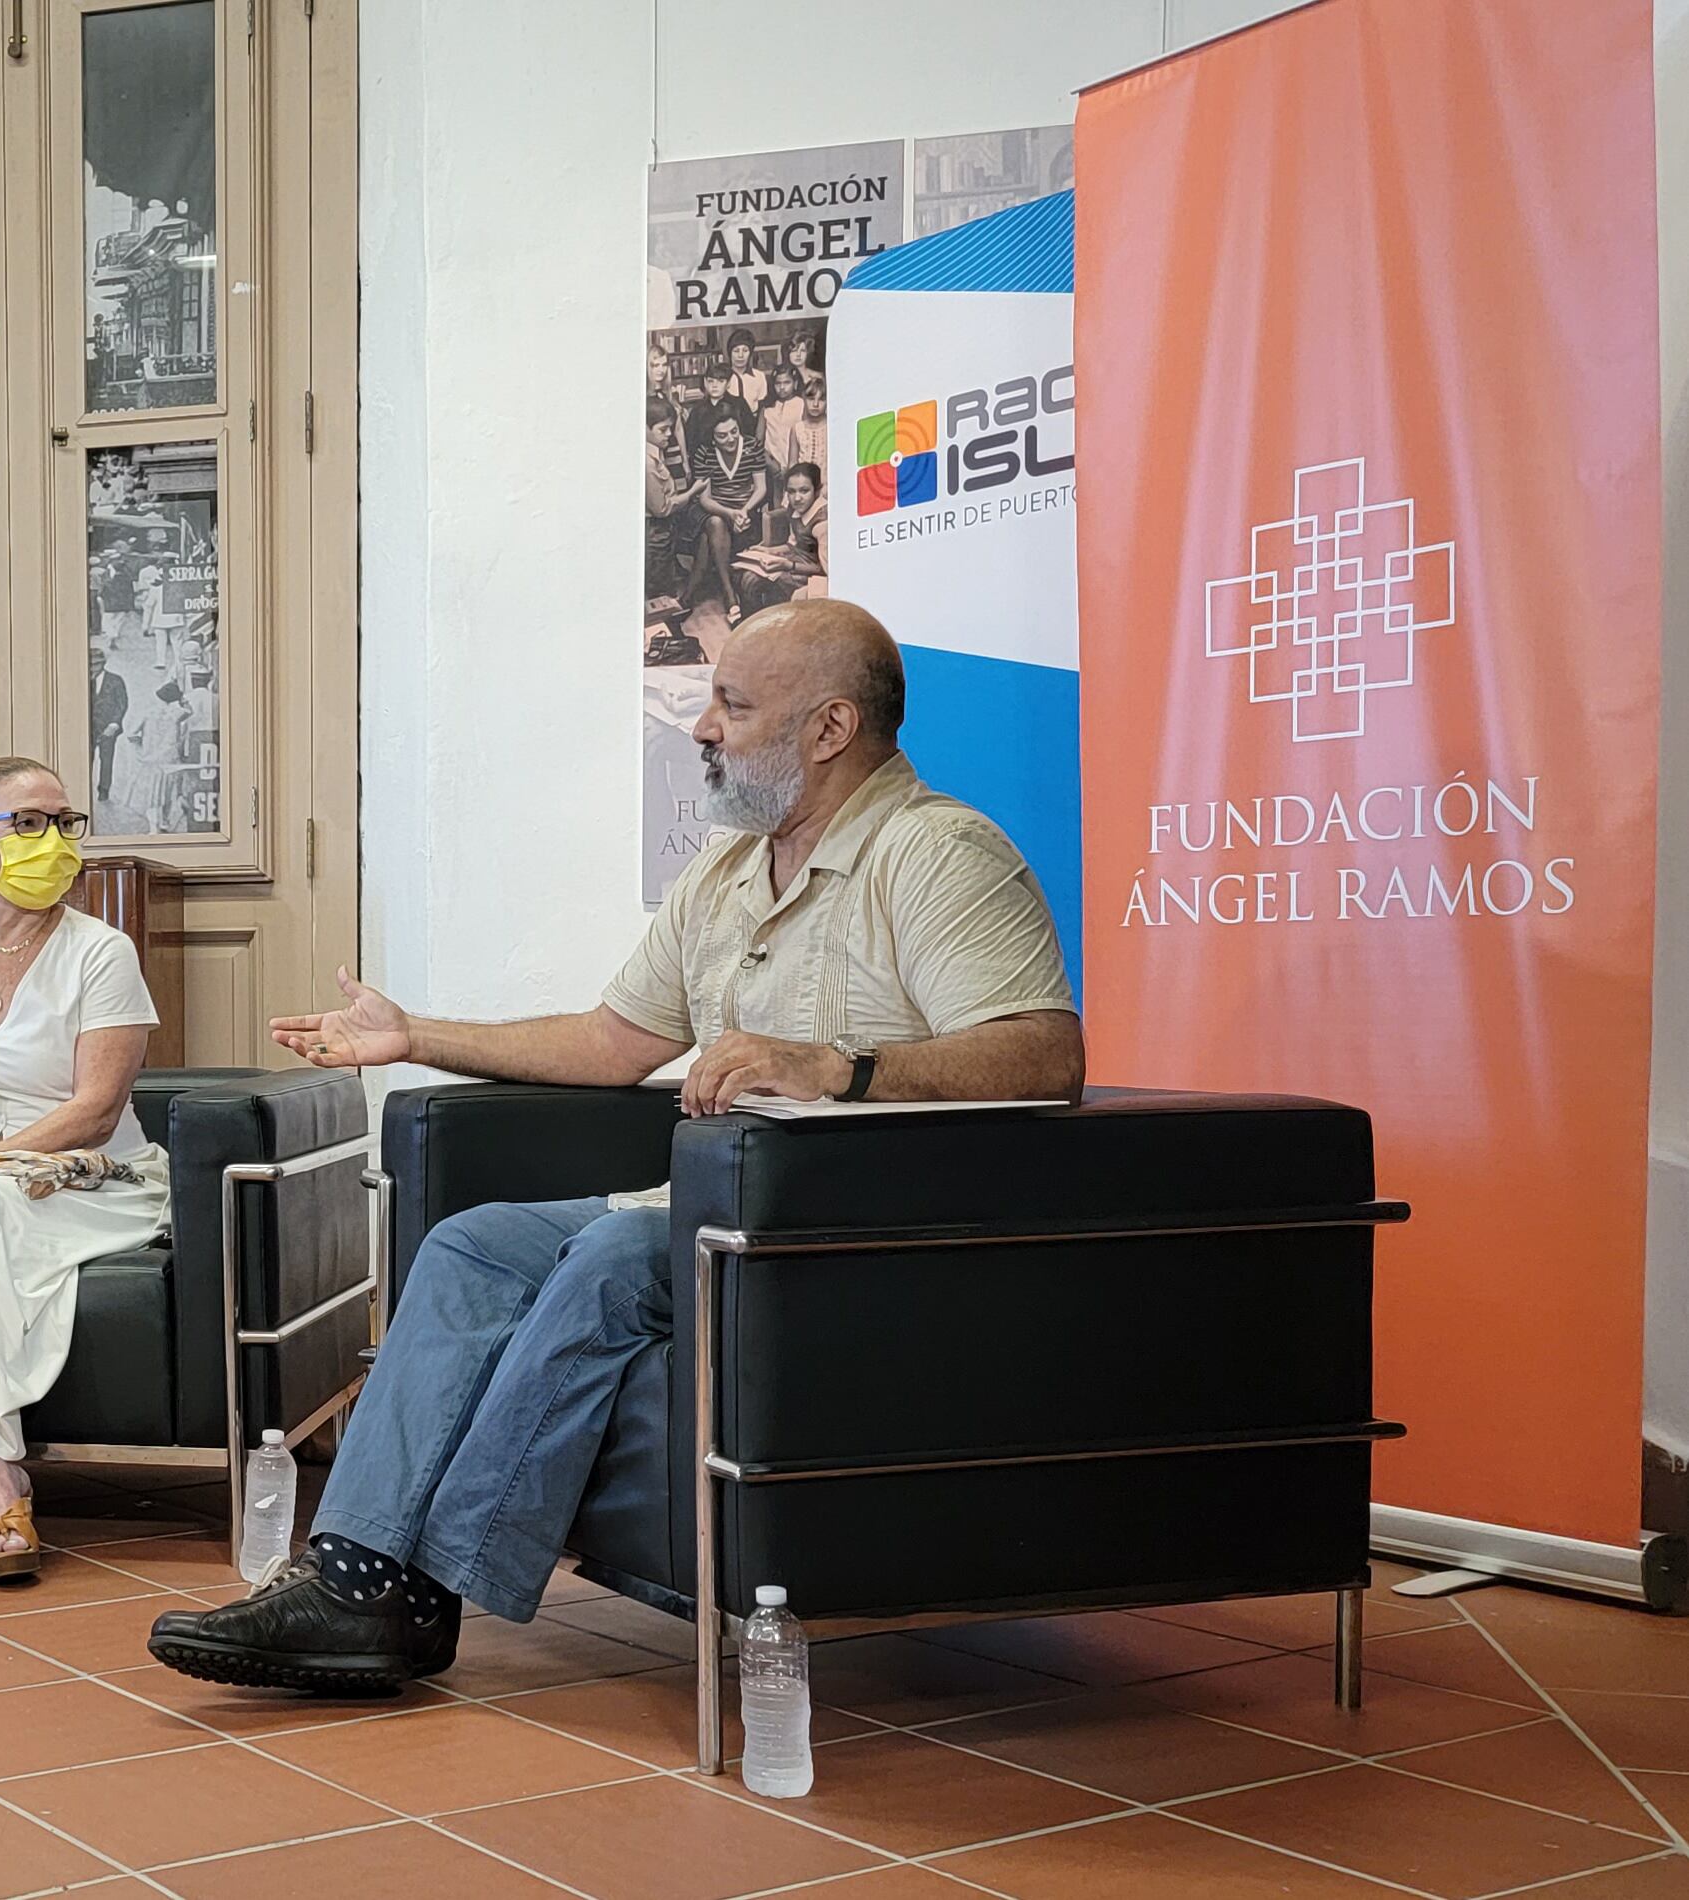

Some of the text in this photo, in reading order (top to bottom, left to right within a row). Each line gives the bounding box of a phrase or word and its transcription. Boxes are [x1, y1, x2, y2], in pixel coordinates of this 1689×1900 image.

[695, 173, 888, 218] FUNDACIÓN
[698, 216, 885, 271] ÁNGEL
[676, 268, 843, 320] RAMO
[947, 425, 1075, 496] ISL
[858, 485, 1077, 550] EL SENTIR DE PUERT
[1148, 771, 1539, 854] FUNDACIÓN
[1119, 857, 1576, 928] ÁNGEL RAMOS
